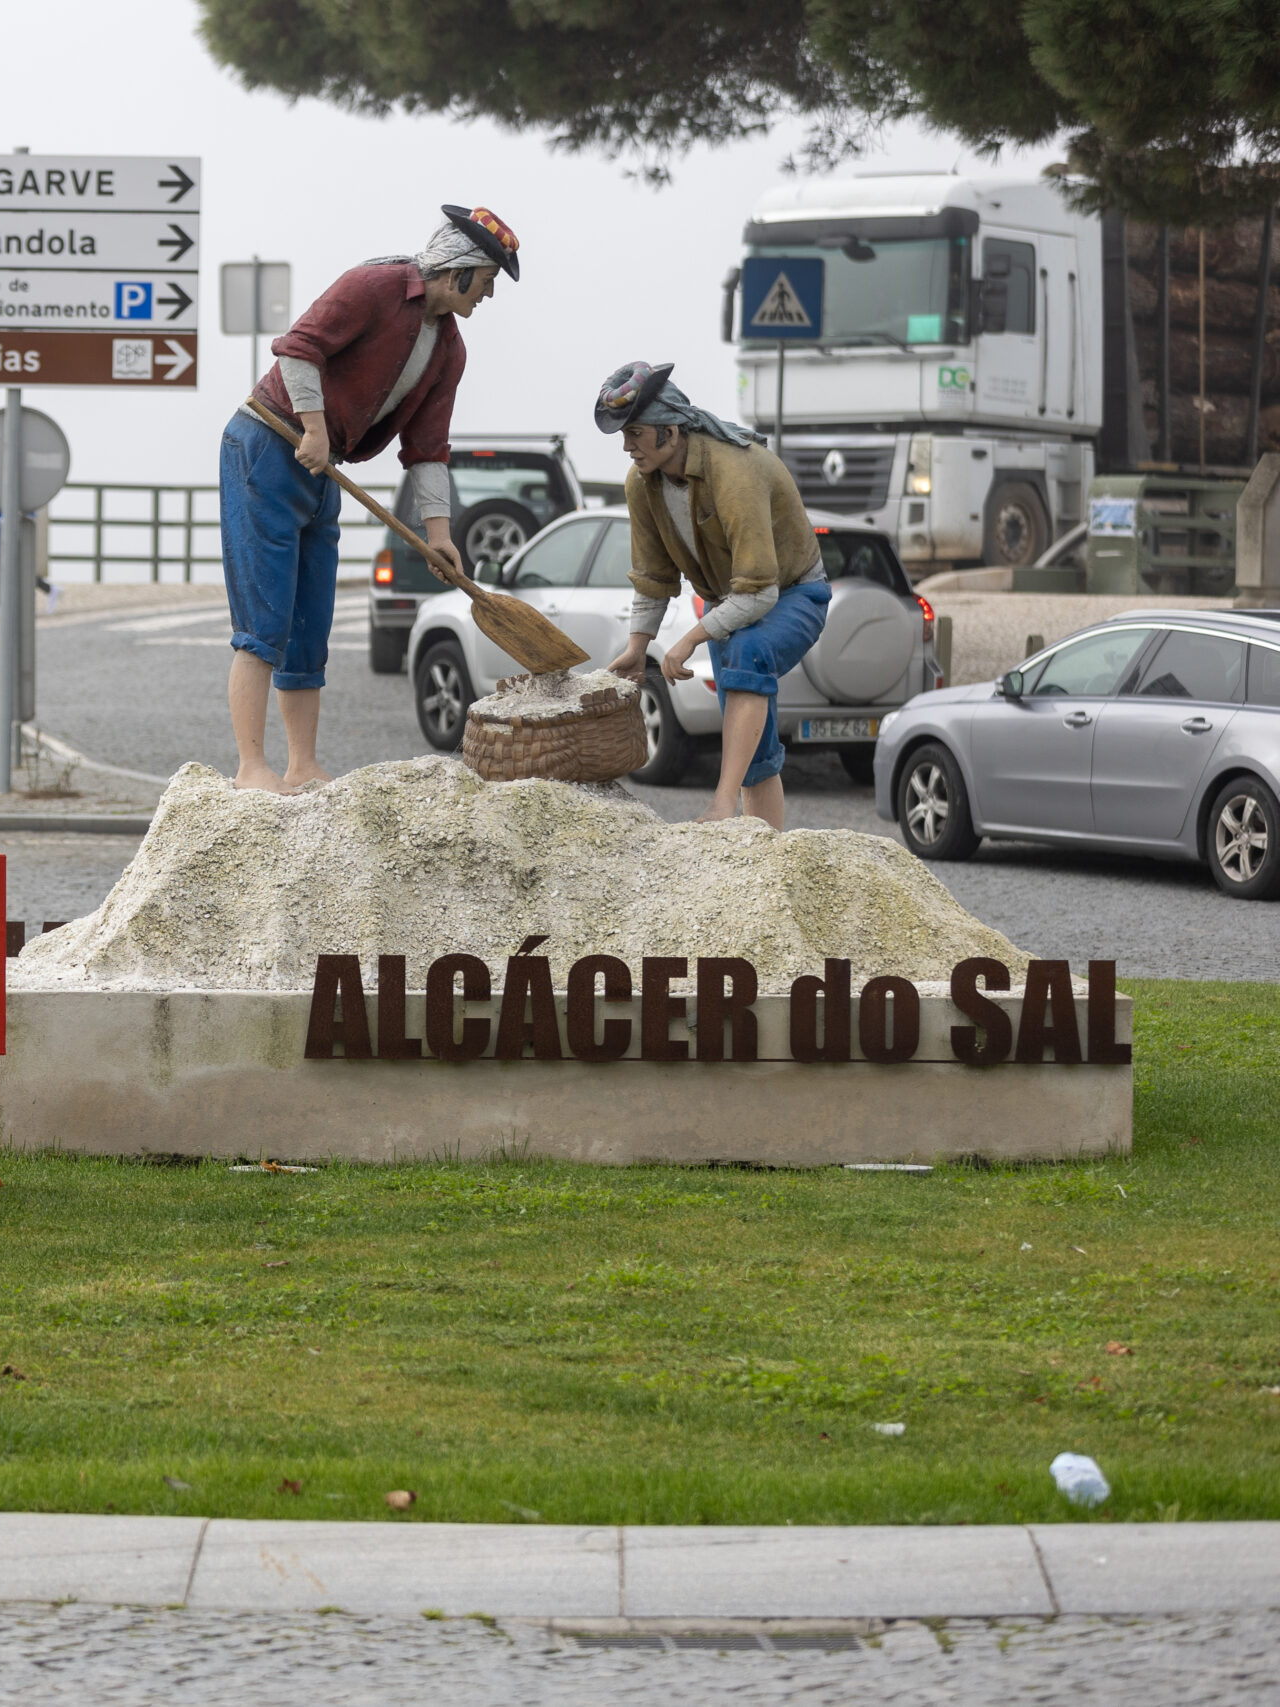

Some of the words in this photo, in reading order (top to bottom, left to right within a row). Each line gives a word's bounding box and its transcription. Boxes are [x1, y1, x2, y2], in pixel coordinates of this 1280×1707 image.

[8, 279, 30, 293] de
[121, 284, 147, 318] P
[304, 935, 758, 1063] ALCÁCER
[789, 958, 919, 1064] do
[950, 957, 1132, 1066] SAL
